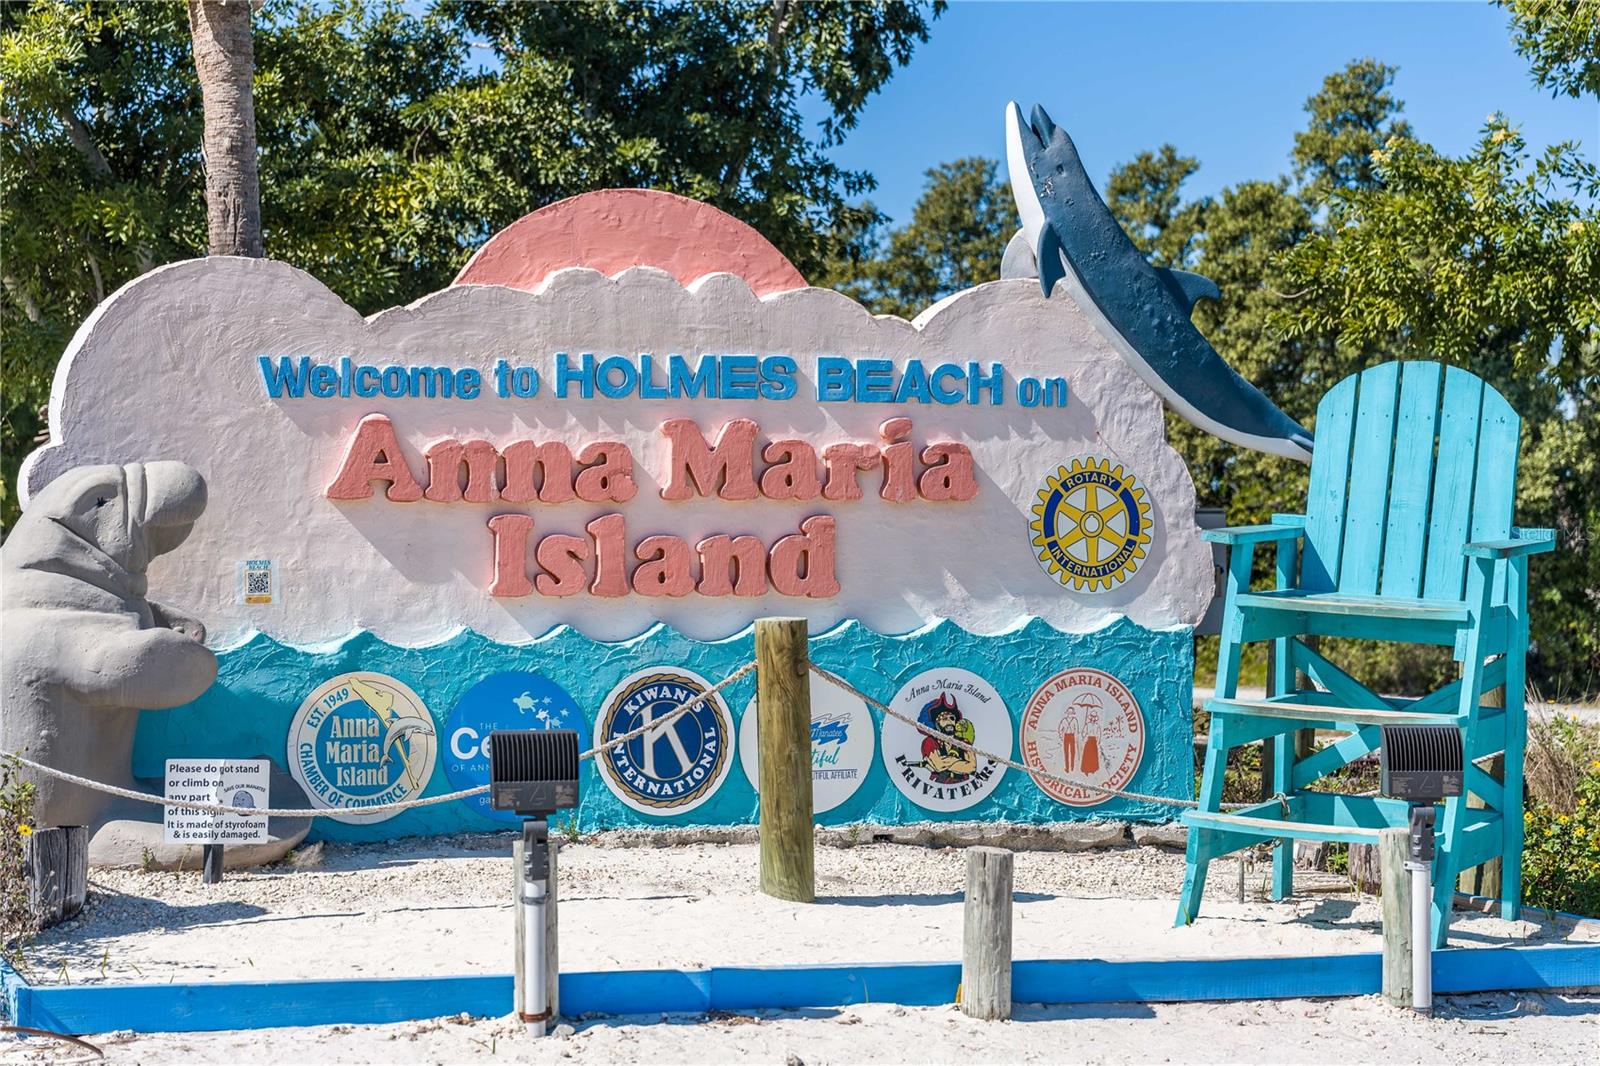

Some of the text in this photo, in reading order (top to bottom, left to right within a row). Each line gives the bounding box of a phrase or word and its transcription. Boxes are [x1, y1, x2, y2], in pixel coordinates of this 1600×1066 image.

[257, 353, 1068, 408] Welcome to HOLMES BEACH on
[324, 412, 980, 503] Anna Maria
[1066, 472, 1116, 486] ROTARY
[487, 513, 840, 598] Island
[1050, 544, 1135, 577] INTERNATIONAL
[905, 678, 992, 704] Anna Maria Island
[306, 687, 349, 729] EST. 1949
[1028, 674, 1138, 733] ANNA MARIA ISLAND
[330, 715, 379, 738] Anna
[480, 722, 498, 730] THE
[640, 701, 695, 779] K
[325, 740, 379, 764] Maria
[169, 764, 260, 774] Please do not stand
[300, 742, 407, 808] CHAMBER OF COMMERCE
[336, 766, 388, 787] Island
[451, 764, 465, 772] OF
[831, 769, 858, 780] AFFILIATE
[182, 778, 210, 787] climb
[189, 793, 211, 802] part
[168, 807, 180, 816] of
[181, 807, 200, 816] this
[167, 820, 266, 831] It is made of styrofoam
[173, 830, 261, 841] & is easily damaged.
